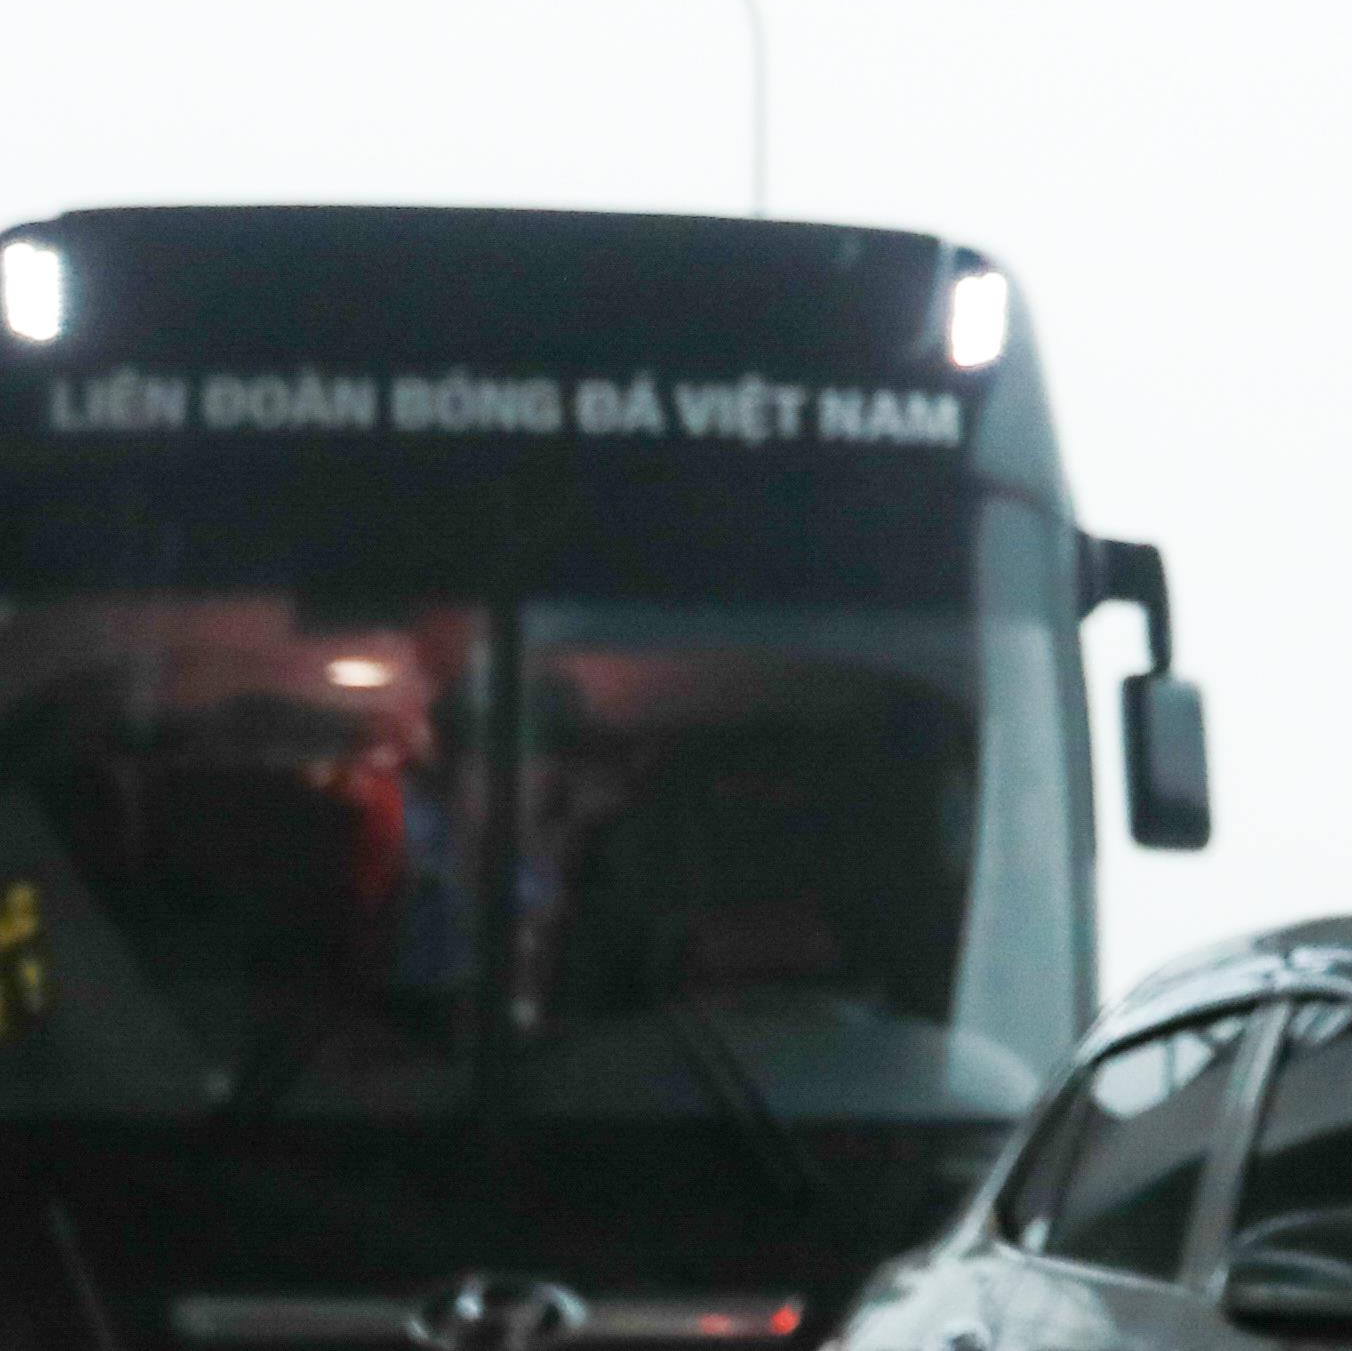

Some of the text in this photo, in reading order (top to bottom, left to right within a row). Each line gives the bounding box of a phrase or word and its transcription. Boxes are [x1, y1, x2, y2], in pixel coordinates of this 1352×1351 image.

[51, 364, 960, 448] LIÊN ĐOÀN BÓNG ĐÁ VIỆT NAM
